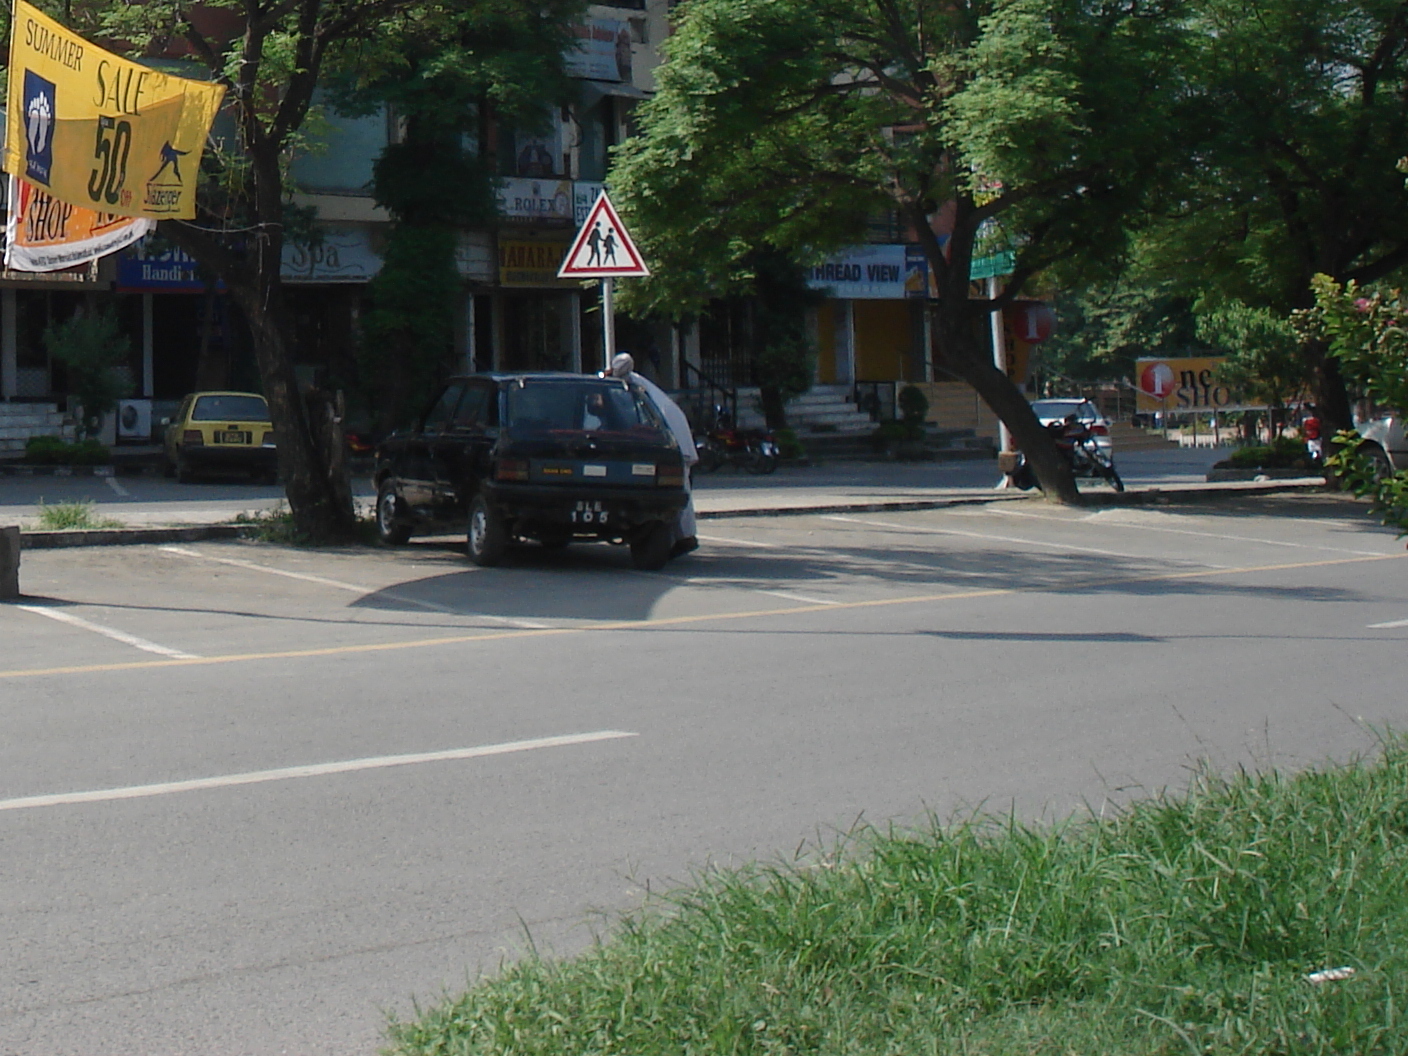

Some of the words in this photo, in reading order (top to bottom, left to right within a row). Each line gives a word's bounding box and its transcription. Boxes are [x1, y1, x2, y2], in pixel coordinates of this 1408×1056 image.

[25, 18, 84, 73] SUMMER
[93, 60, 148, 116] SALE
[88, 115, 132, 204] 50
[27, 200, 72, 242] SHOP
[515, 198, 556, 212] ROLEX
[867, 264, 900, 283] VIEW
[1176, 385, 1241, 408] SHO
